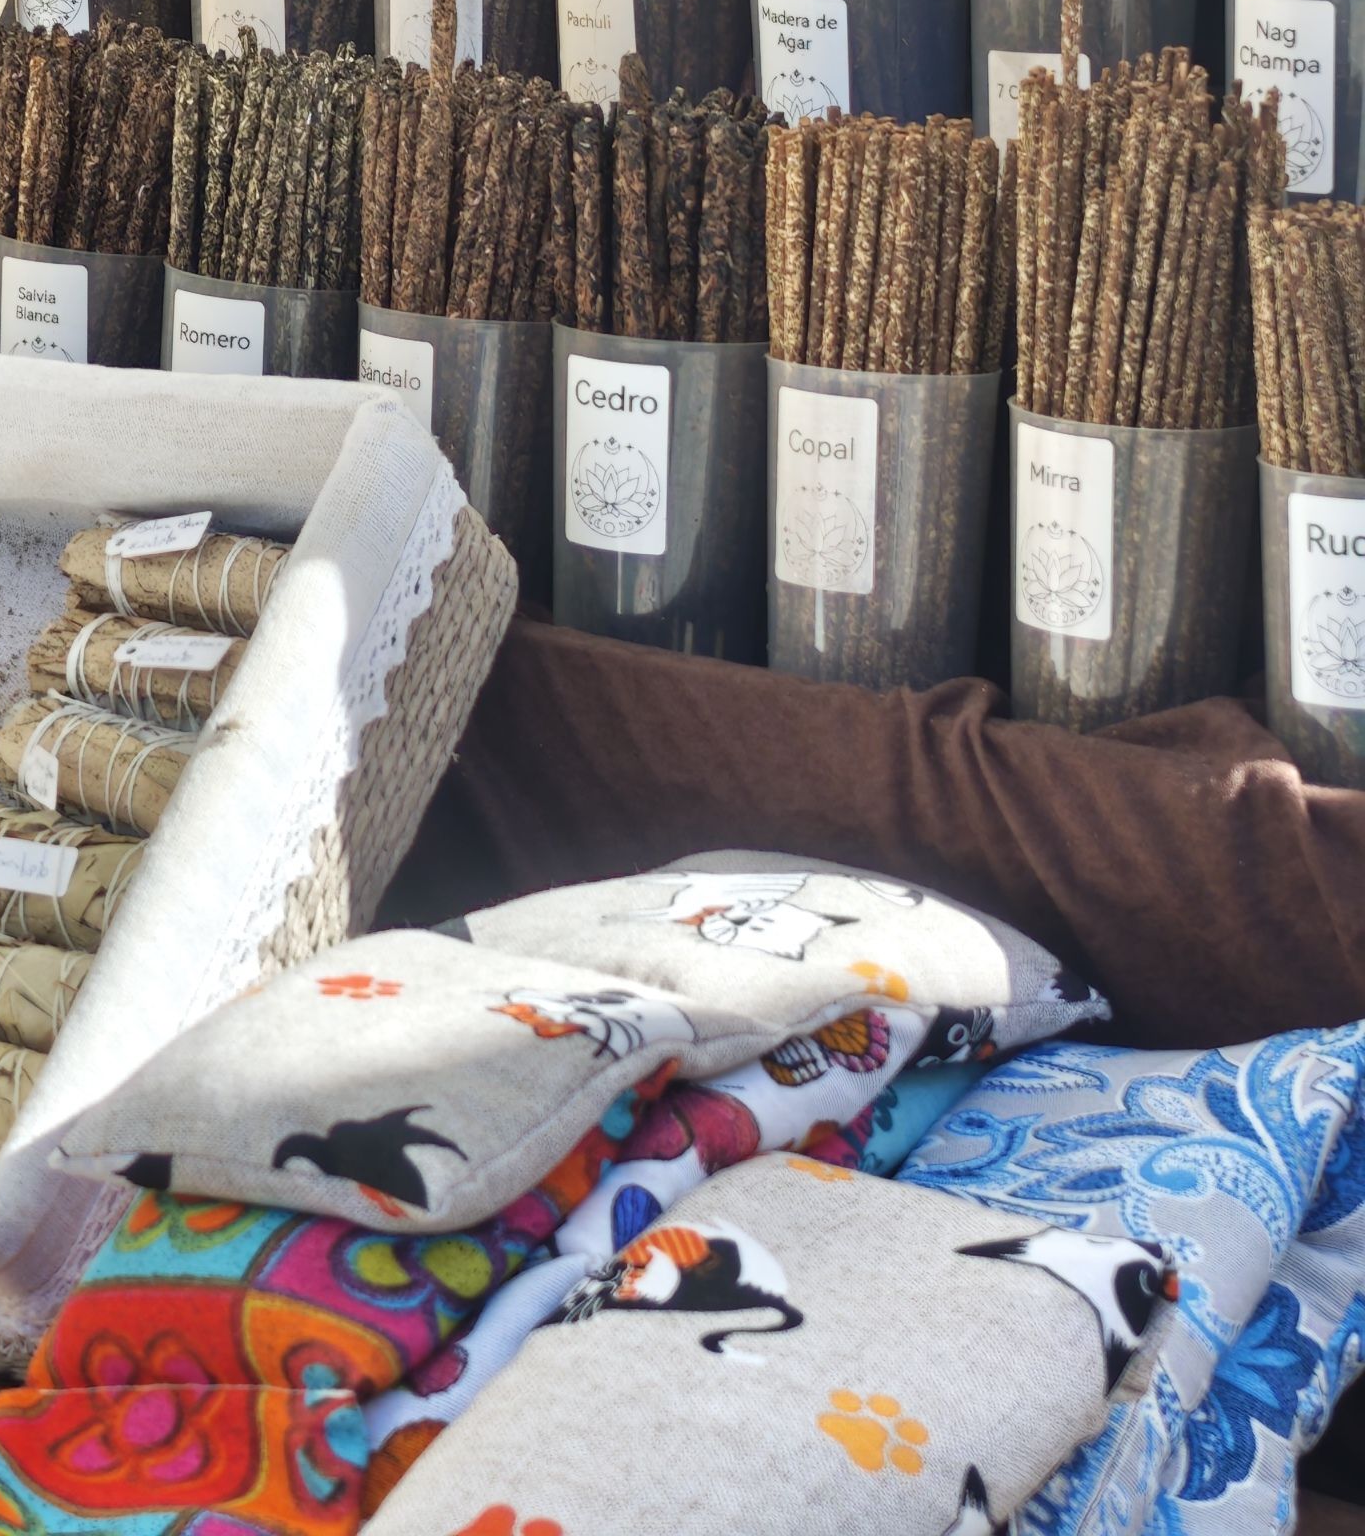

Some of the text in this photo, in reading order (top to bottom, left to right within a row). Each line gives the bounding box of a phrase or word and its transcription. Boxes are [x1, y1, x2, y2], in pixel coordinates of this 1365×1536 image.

[566, 10, 612, 32] Pachuli
[760, 5, 838, 30] Madera de
[777, 32, 813, 54] Agar
[1256, 19, 1297, 49] Nag
[1239, 41, 1321, 78] Champa
[997, 83, 1004, 99] 7
[18, 286, 57, 305] Salvia
[16, 305, 60, 325] Blanca
[179, 322, 251, 351] Romero
[359, 360, 422, 392] Sándalo
[575, 379, 658, 415] Cedro
[788, 428, 855, 464] Copal
[1030, 461, 1081, 493] Mirra
